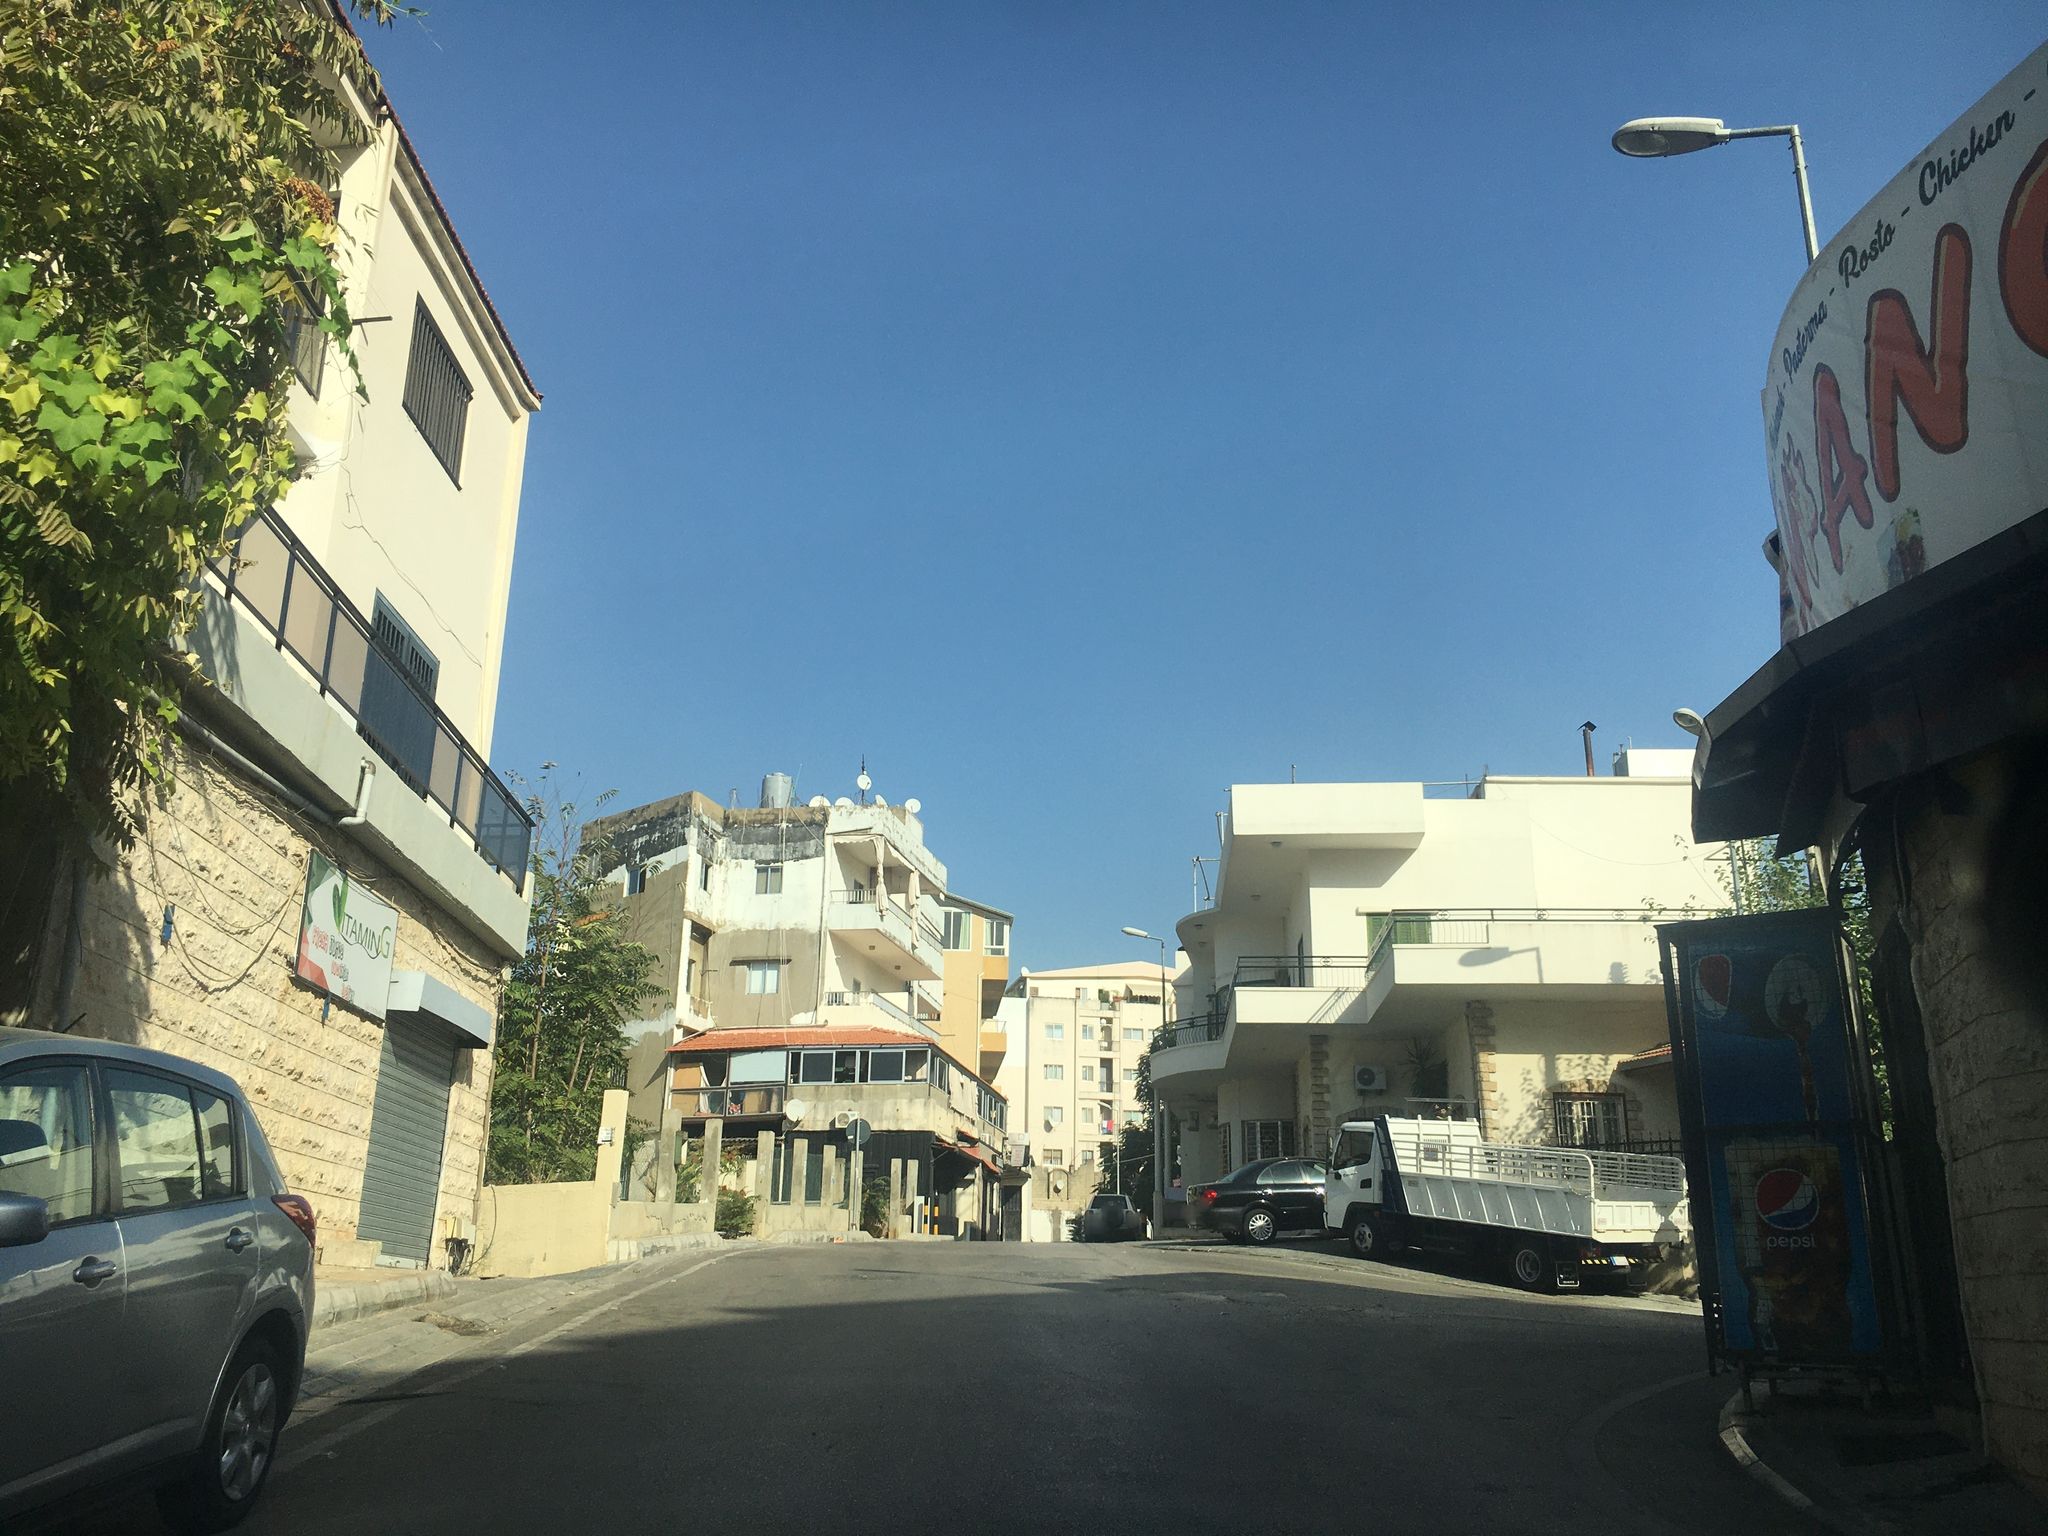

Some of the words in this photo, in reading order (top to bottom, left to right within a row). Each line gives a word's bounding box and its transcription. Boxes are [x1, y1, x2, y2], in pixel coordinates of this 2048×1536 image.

[1839, 219, 1896, 288] Rosto
[1919, 109, 2016, 206] Chicken
[1766, 1232, 1817, 1251] pepsi
